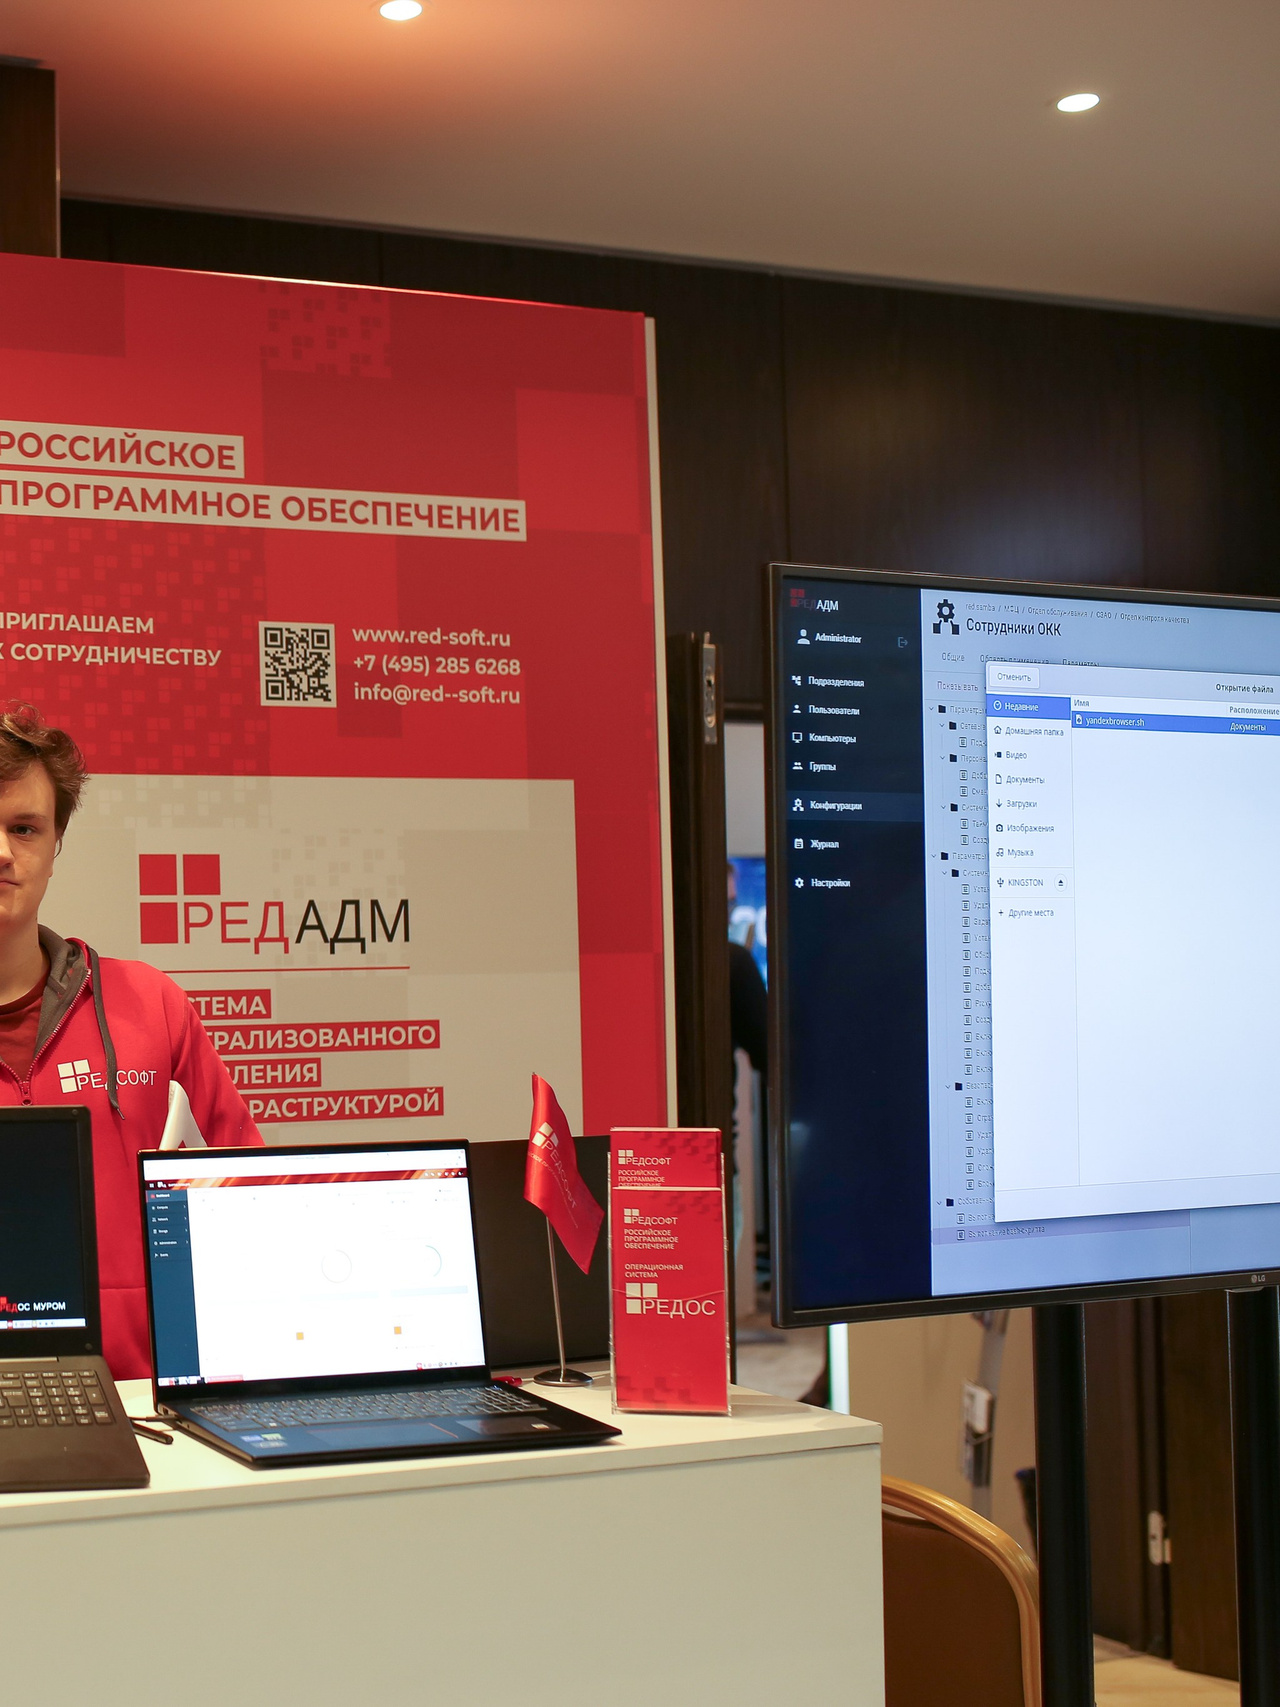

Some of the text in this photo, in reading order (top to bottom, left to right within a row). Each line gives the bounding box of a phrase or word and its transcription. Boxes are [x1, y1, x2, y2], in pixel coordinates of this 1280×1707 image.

[280, 495, 521, 533] ОБЕСПЕЧЕНИЕ
[966, 617, 1062, 636] Сотрудники ОКК
[352, 626, 511, 648] www.red-soft.ru
[815, 632, 862, 644] Administrator
[9, 642, 222, 668] СОТРУДНИЧЕСТВУ
[353, 653, 521, 677] +7 (495) 285 6268
[808, 675, 865, 689] Подразделения
[997, 672, 1032, 683] Отменить
[354, 682, 521, 707] info@red--soft.ru
[1215, 683, 1274, 695] Открытие файла
[1004, 702, 1039, 712] Недавние
[1073, 699, 1090, 708] Имя
[809, 704, 860, 716] Пользователи
[1229, 705, 1280, 716] Расположение
[1085, 716, 1145, 729] yandexbrowser.sh
[1229, 722, 1267, 734] Документы
[1005, 726, 1065, 738] Домашняя папка
[809, 732, 857, 745] Компьютеры
[1005, 751, 1028, 760] Видео
[809, 761, 837, 774] Группы
[1006, 775, 1046, 786] Документы
[810, 800, 863, 812] Конфигурации
[1006, 799, 1038, 810] Загрузки
[1006, 823, 1055, 834] Изображения
[810, 838, 839, 850] Журнал
[1007, 848, 1035, 858] Музыка
[811, 876, 851, 889] Настройки
[1007, 878, 1044, 887] KINGSTON
[1008, 908, 1055, 919] Другие места
[188, 995, 267, 1016] ТЕМА
[225, 1063, 318, 1084] ЛЕНИЯ
[76, 1069, 157, 1091] РЕСОФТ
[626, 1157, 671, 1167] РЕДСОФТ
[631, 1216, 678, 1226] РЕДСОФТ
[624, 1228, 671, 1236] РОССИЙСКОЕ
[624, 1263, 684, 1271] ОПЕРАЦИОННАЯ
[1257, 1274, 1266, 1283] LG
[33, 1301, 66, 1312] МУРОМ
